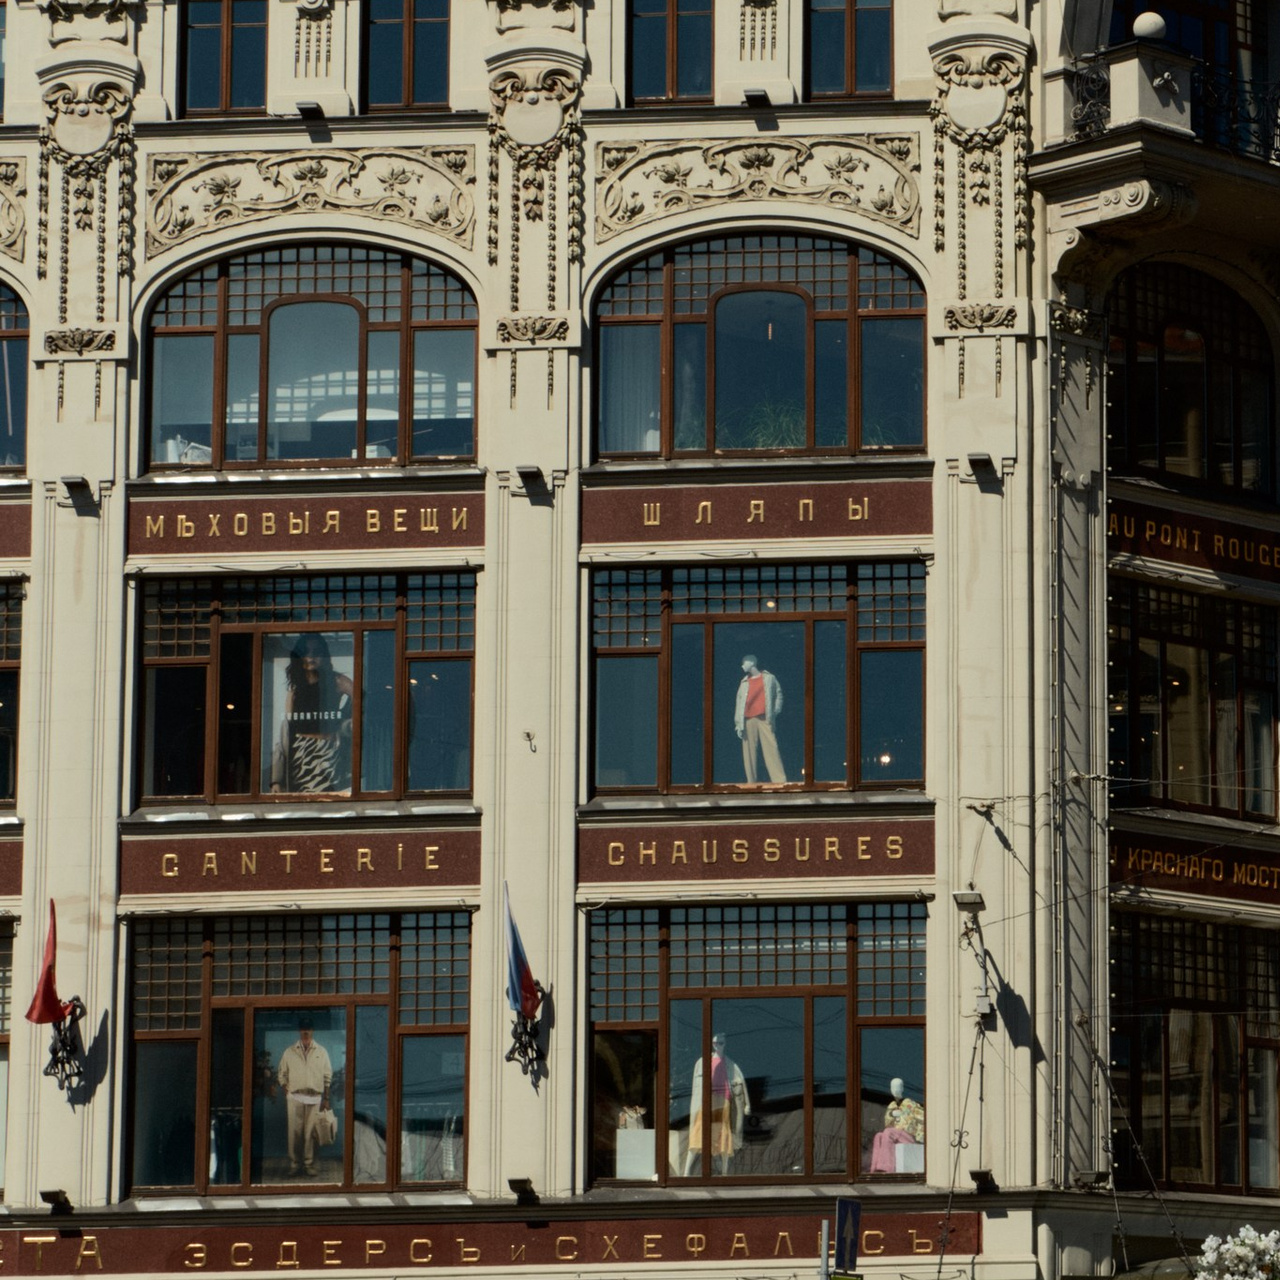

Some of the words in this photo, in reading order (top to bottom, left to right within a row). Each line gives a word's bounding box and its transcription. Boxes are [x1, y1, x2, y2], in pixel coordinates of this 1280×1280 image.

[366, 507, 468, 534] ВЕЩИ
[643, 497, 869, 526] ШЛЯПЫ
[1109, 512, 1135, 539] AU
[1145, 520, 1201, 552] PONT
[607, 835, 904, 866] CHAUSSURES
[1128, 846, 1224, 882] КРАСНАГО
[0, 1235, 103, 1271] ТА
[184, 1238, 481, 1269] ЭСДЕРСЪ
